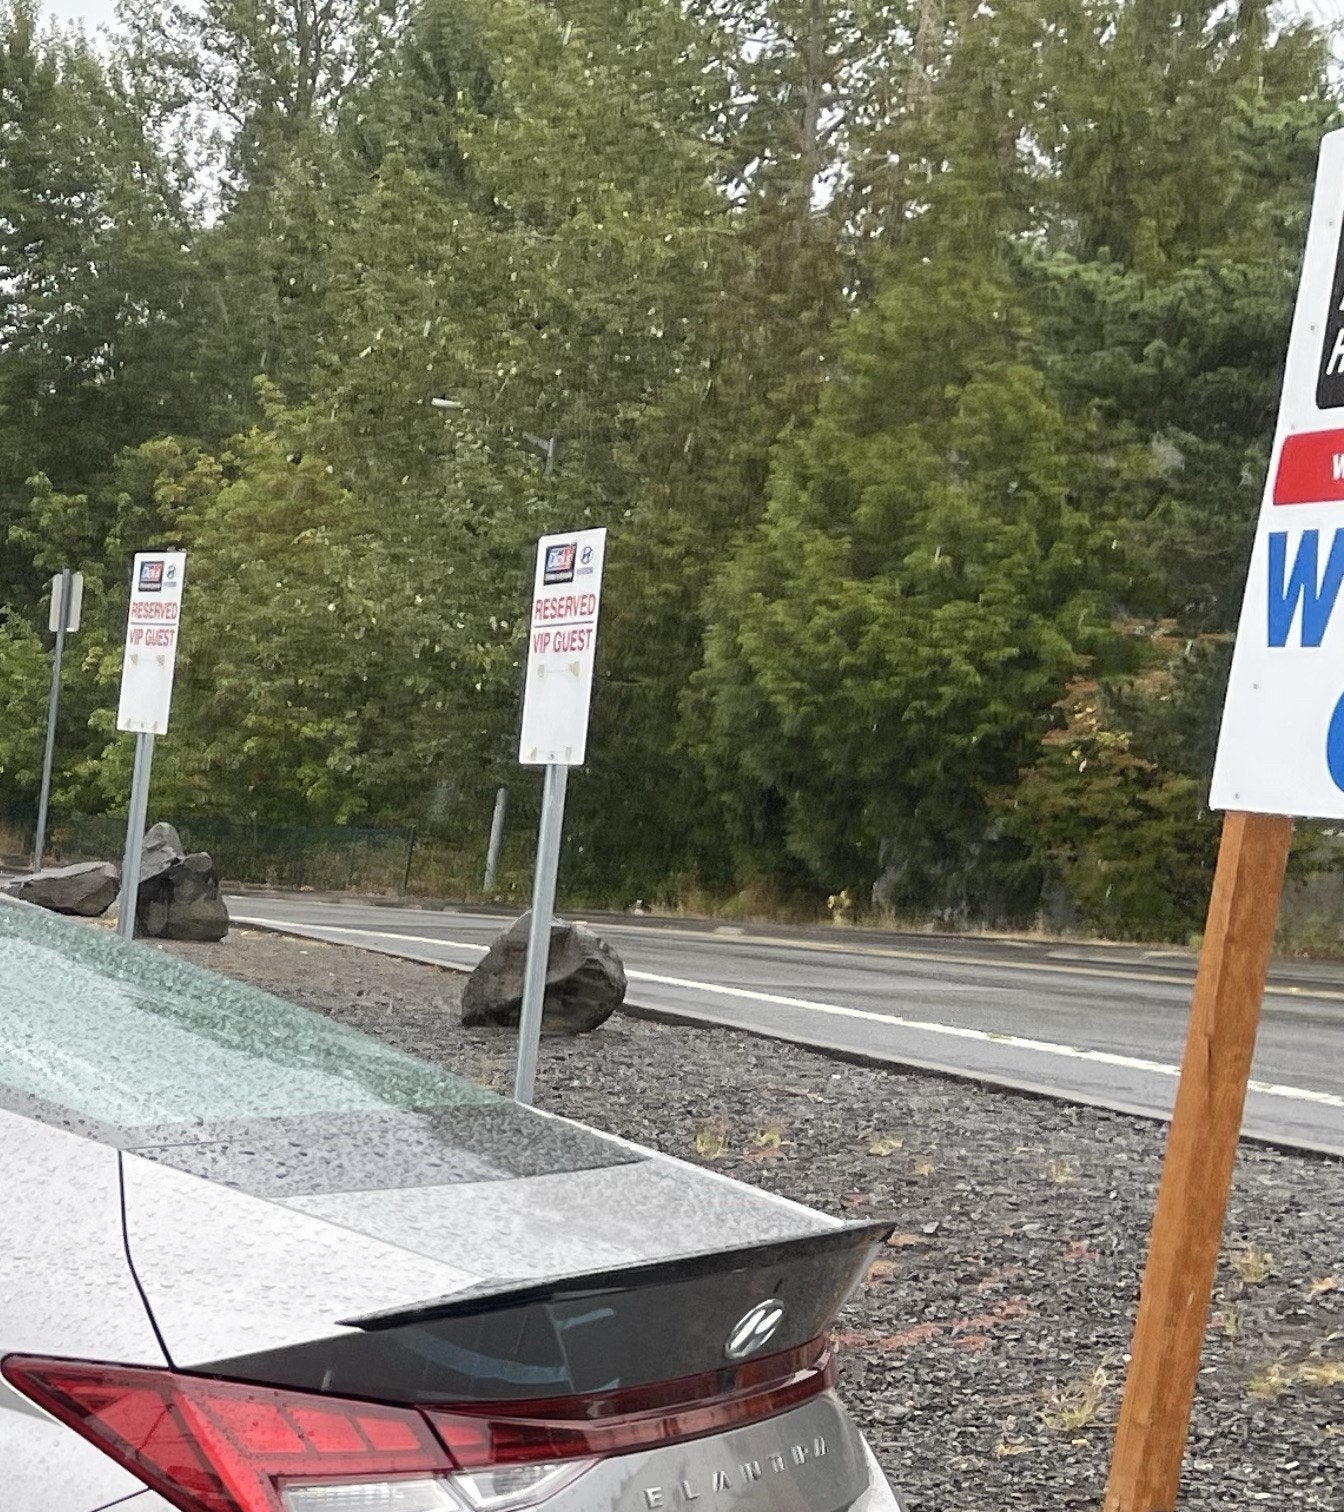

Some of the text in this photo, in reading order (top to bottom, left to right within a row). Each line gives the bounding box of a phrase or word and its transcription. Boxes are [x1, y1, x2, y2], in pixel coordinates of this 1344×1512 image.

[131, 602, 178, 619] RESERVED
[535, 594, 595, 619] RESERVED
[129, 628, 175, 647] VIP GUEST
[533, 628, 593, 654] VIP GUEST
[643, 1435, 829, 1510] ELANTRA
